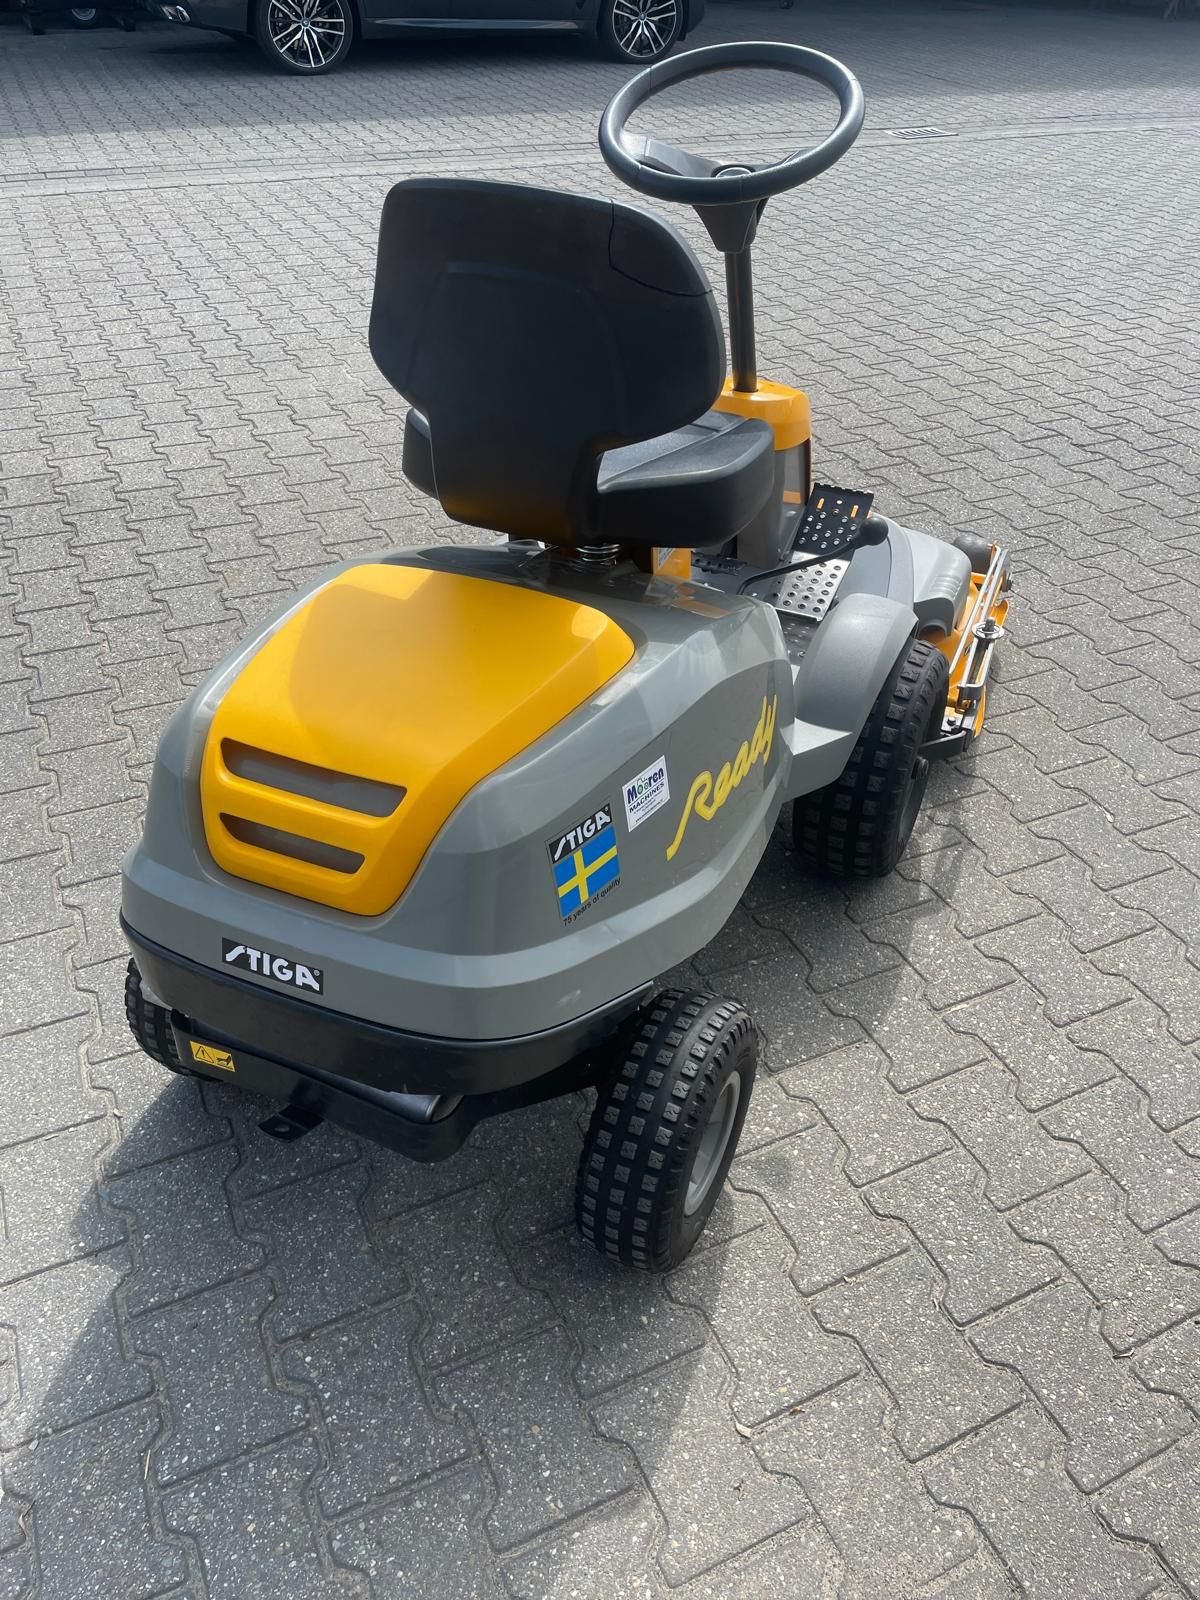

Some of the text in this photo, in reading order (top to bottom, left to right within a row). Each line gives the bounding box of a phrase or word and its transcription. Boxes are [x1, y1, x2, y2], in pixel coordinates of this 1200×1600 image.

[626, 767, 665, 804] Mooren
[629, 782, 665, 814] MACHINES
[666, 694, 777, 862] Ready
[554, 810, 611, 861] STIGA
[573, 901, 592, 920] years
[592, 894, 600, 904] of
[600, 877, 620, 897] quality
[225, 945, 320, 991] STIGA
